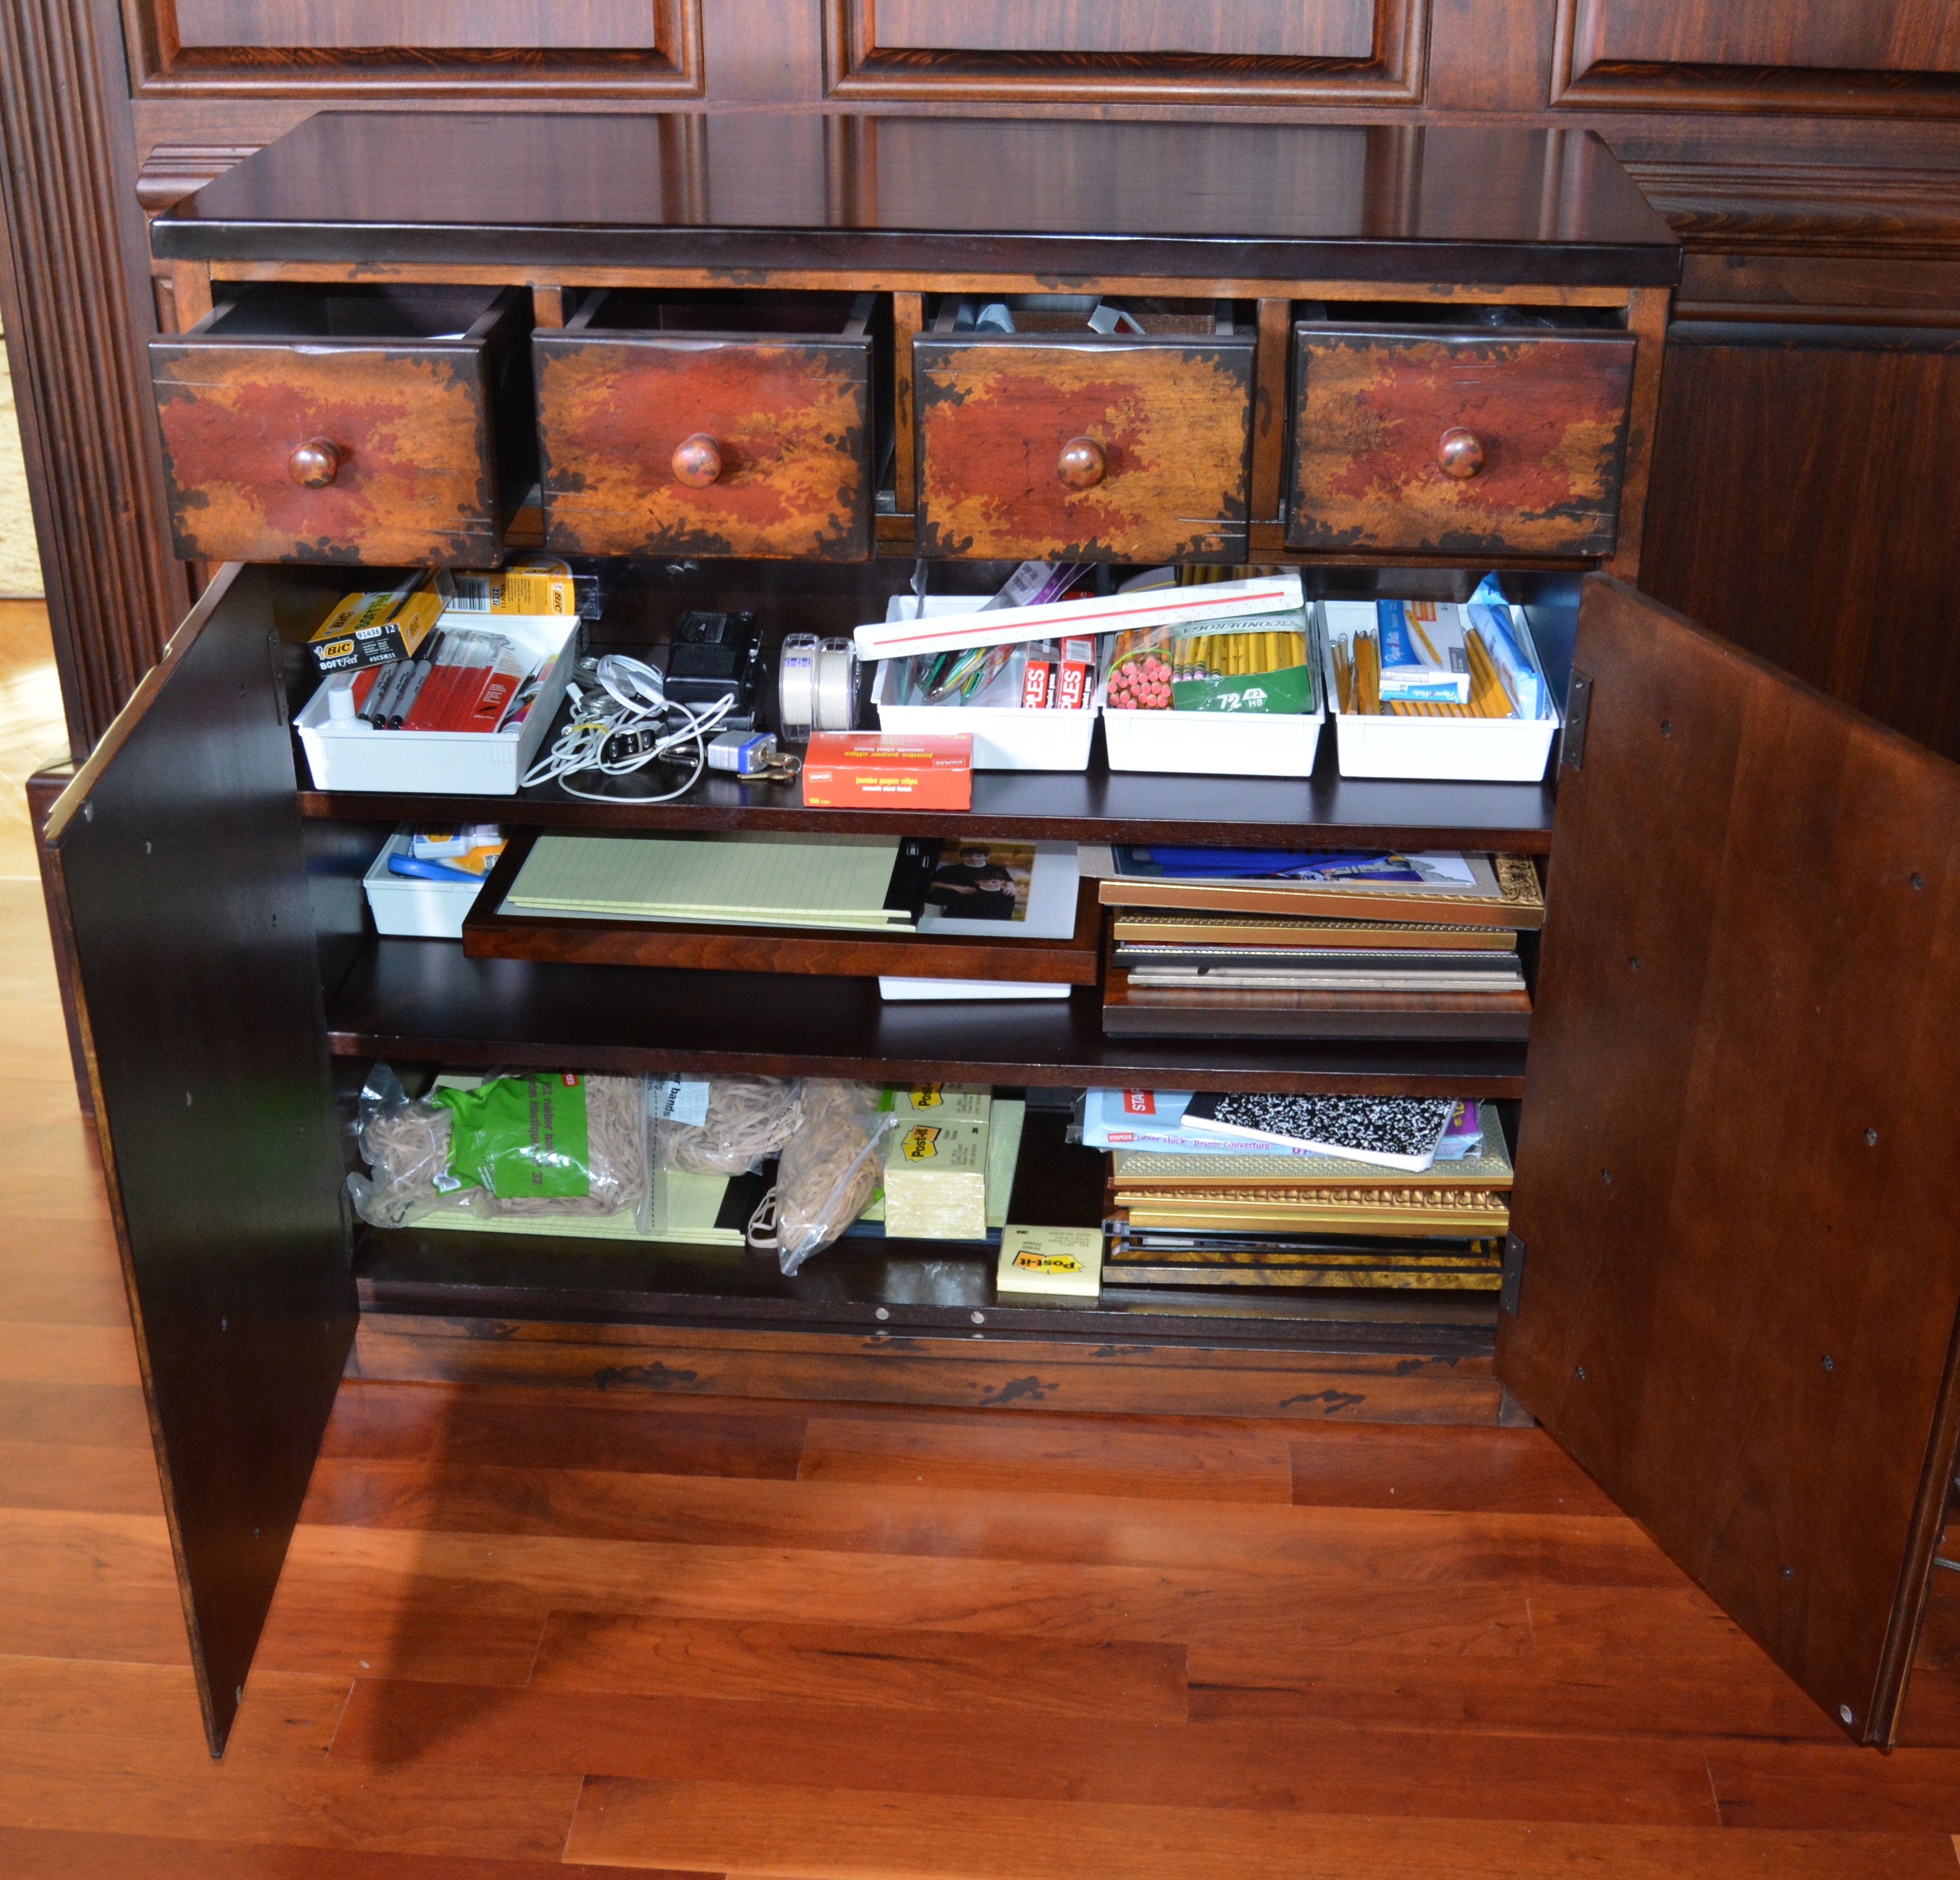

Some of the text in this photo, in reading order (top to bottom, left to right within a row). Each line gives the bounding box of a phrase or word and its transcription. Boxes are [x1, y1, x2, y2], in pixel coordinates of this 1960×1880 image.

[554, 592, 562, 614] BIC
[332, 611, 352, 629] BIC
[410, 618, 420, 635] BIC
[358, 629, 380, 639] 91436
[327, 643, 351, 656] BIC
[1217, 694, 1242, 710] 72
[1248, 699, 1263, 707] HB
[856, 776, 878, 785] jumbo
[663, 1088, 681, 1117] bands
[544, 1098, 553, 1130] rubber
[545, 1134, 554, 1167] bans
[911, 1128, 928, 1158] Post-it
[1162, 1136, 1185, 1144] stock
[1194, 1139, 1220, 1147] papier
[1224, 1140, 1270, 1150] couverture
[532, 1172, 543, 1185] 32
[1020, 1258, 1075, 1269] Post-it
